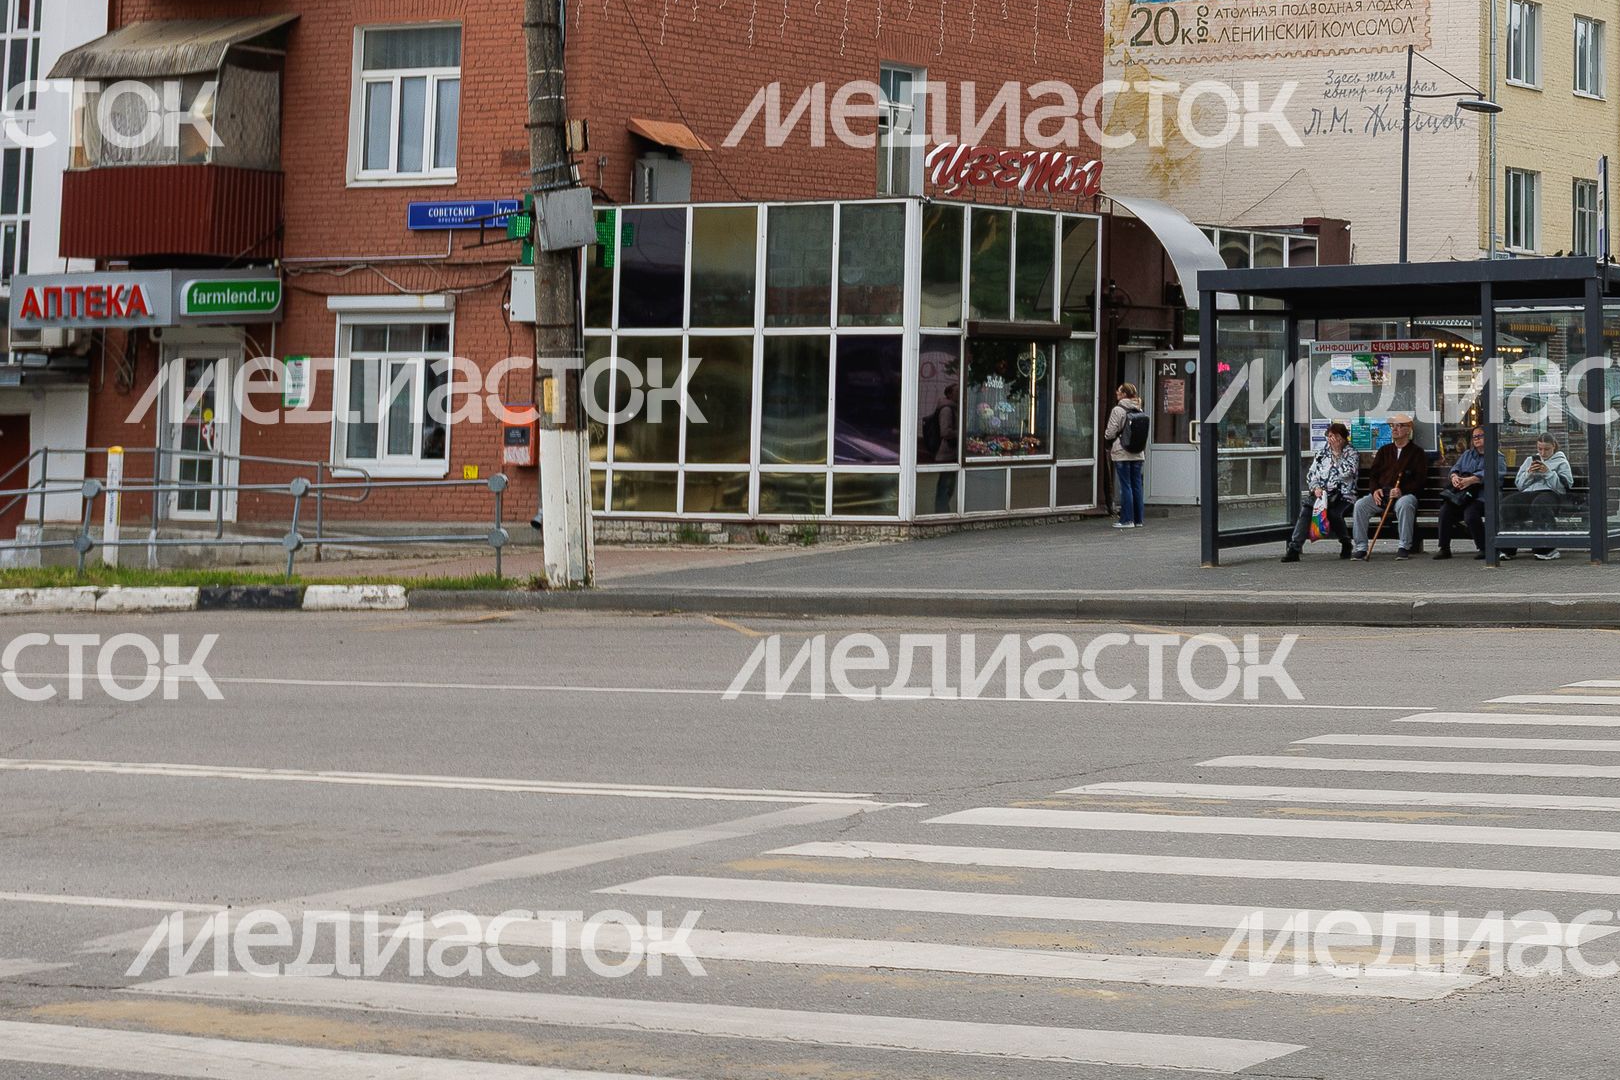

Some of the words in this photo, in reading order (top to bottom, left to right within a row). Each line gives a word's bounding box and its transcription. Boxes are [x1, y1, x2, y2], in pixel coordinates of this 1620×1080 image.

[1214, 5, 1277, 19] АТОМНАЯ
[1281, 0, 1363, 17] ПОДВОДНАЯ
[1197, 5, 1210, 44] 1970
[1325, 70, 1361, 86] Здесь
[1366, 70, 1396, 83] жил
[1323, 81, 1438, 103] контр-адмрал
[428, 205, 475, 218] СОВЕТСКИЙ
[20, 283, 152, 319] АПТЕКА
[192, 289, 275, 305] farmlend.ru
